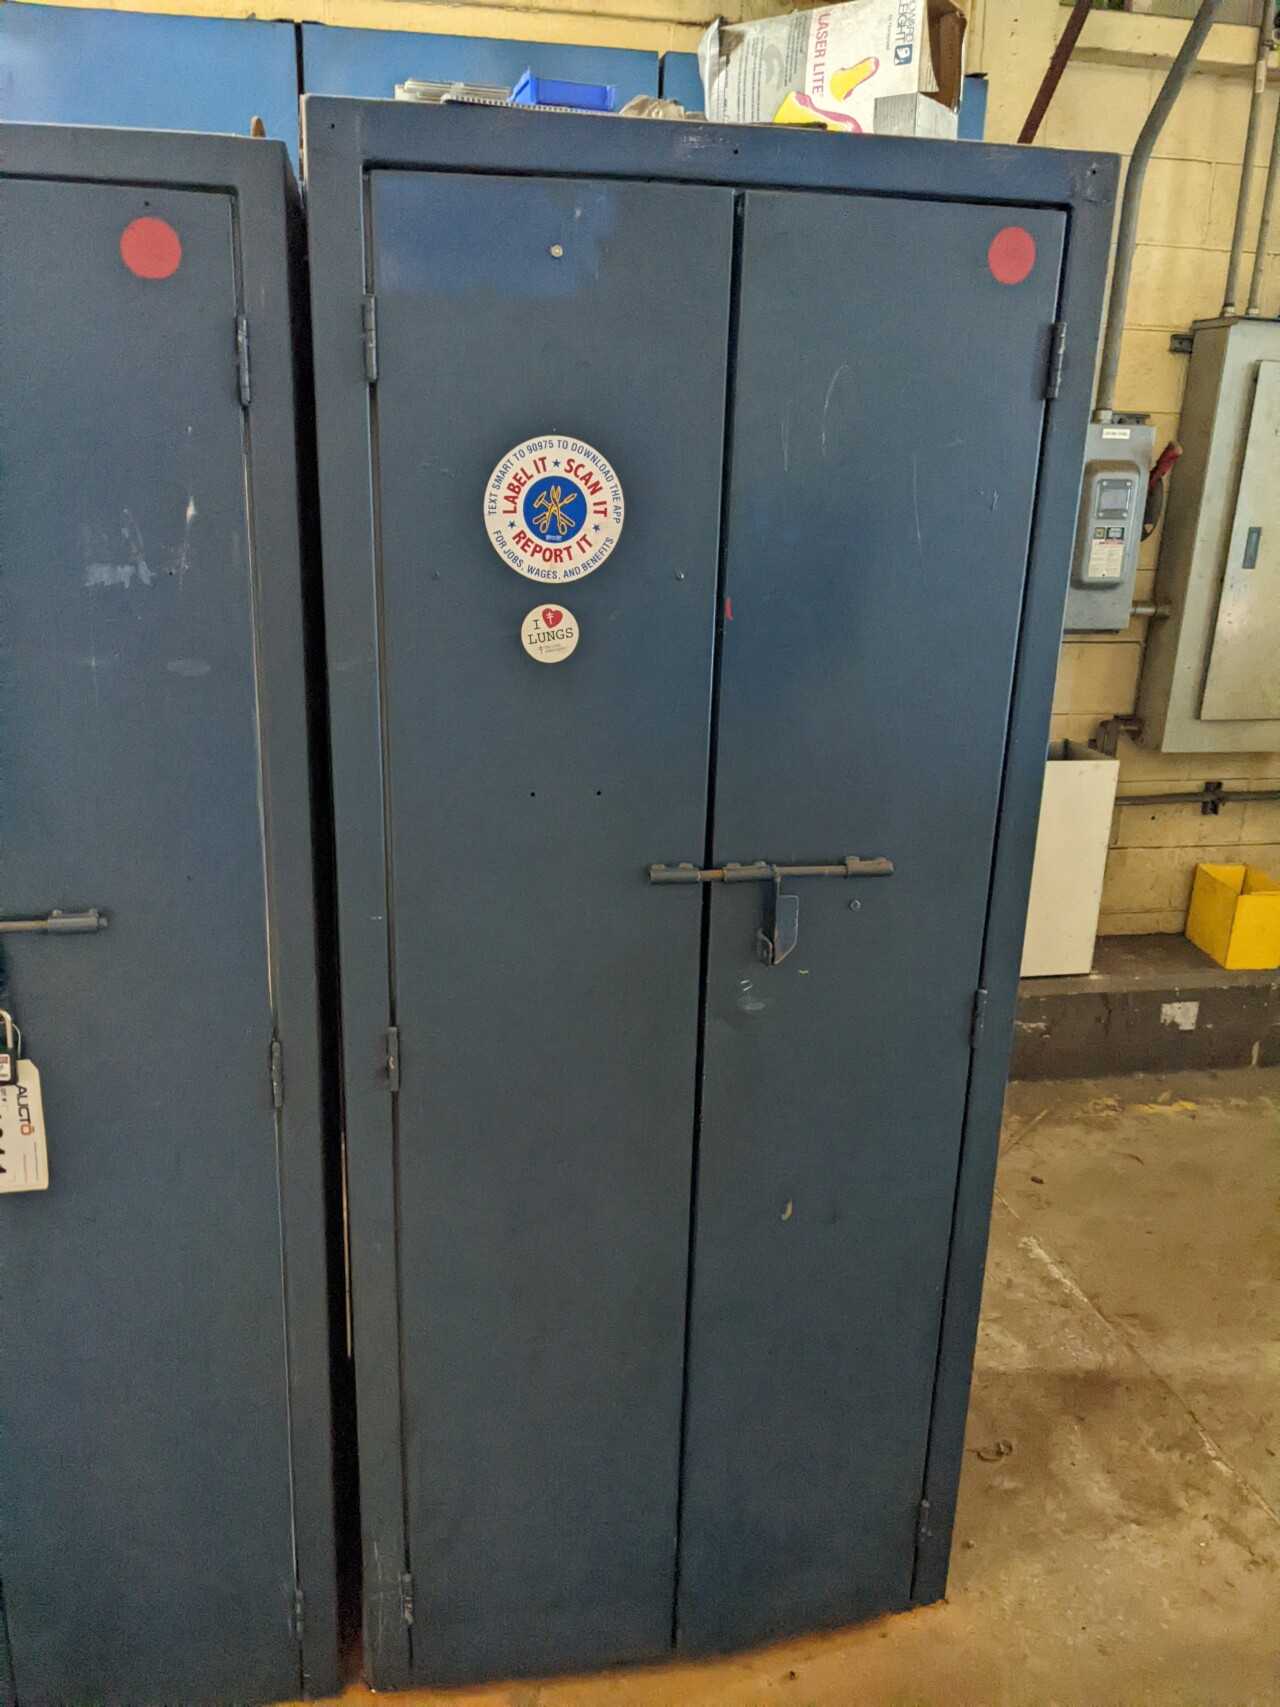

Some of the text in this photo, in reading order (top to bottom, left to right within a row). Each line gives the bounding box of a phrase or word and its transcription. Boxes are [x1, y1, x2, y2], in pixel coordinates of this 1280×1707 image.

[812, 12, 832, 97] LASER LITE
[488, 439, 622, 524] TEXT SMART TO 90975 TO DOWNLOAD THE APP
[502, 456, 548, 515] LABEL IT
[564, 458, 608, 517] SCAN IT
[494, 529, 614, 580] FOR JOBS, WAGES, AND BENEFITS
[512, 529, 593, 564] REPORT IT
[527, 627, 574, 645] LUNGS
[532, 619, 541, 630] I
